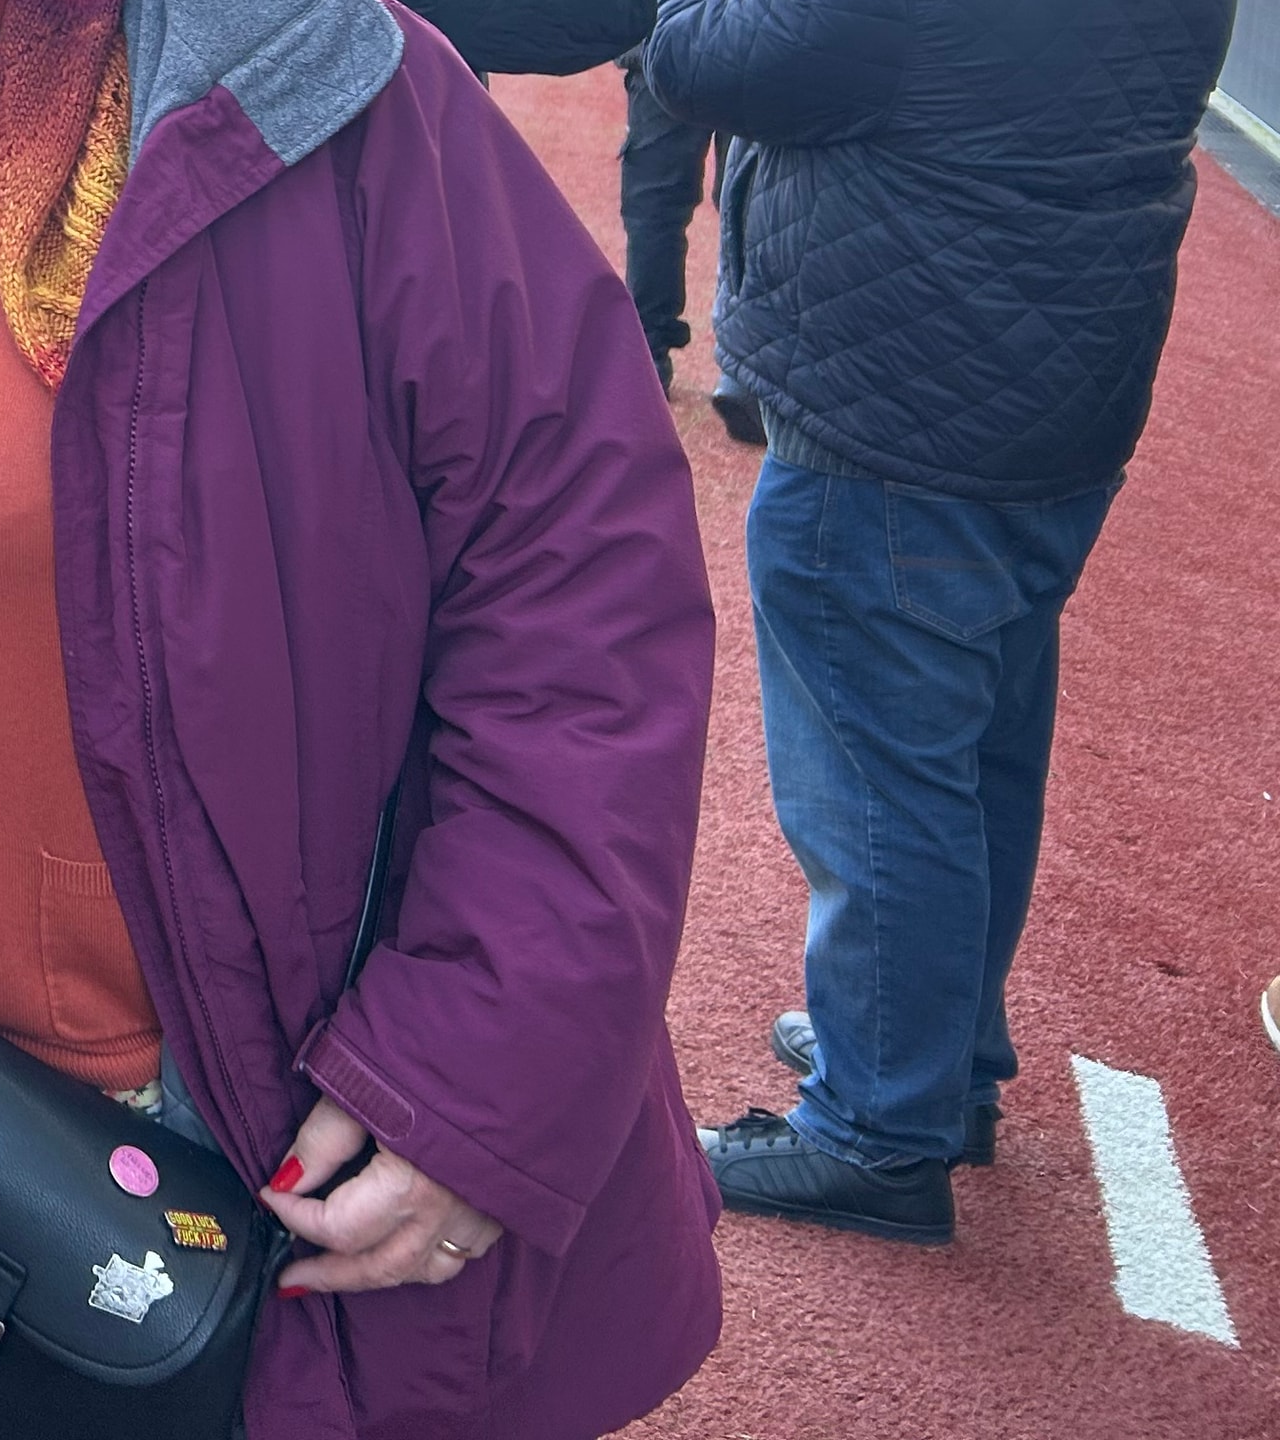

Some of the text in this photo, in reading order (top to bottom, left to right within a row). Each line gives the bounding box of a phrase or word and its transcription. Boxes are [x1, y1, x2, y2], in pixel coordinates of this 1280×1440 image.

[168, 1211, 219, 1230] GOOD LUCK
[212, 1234, 225, 1248] UP
